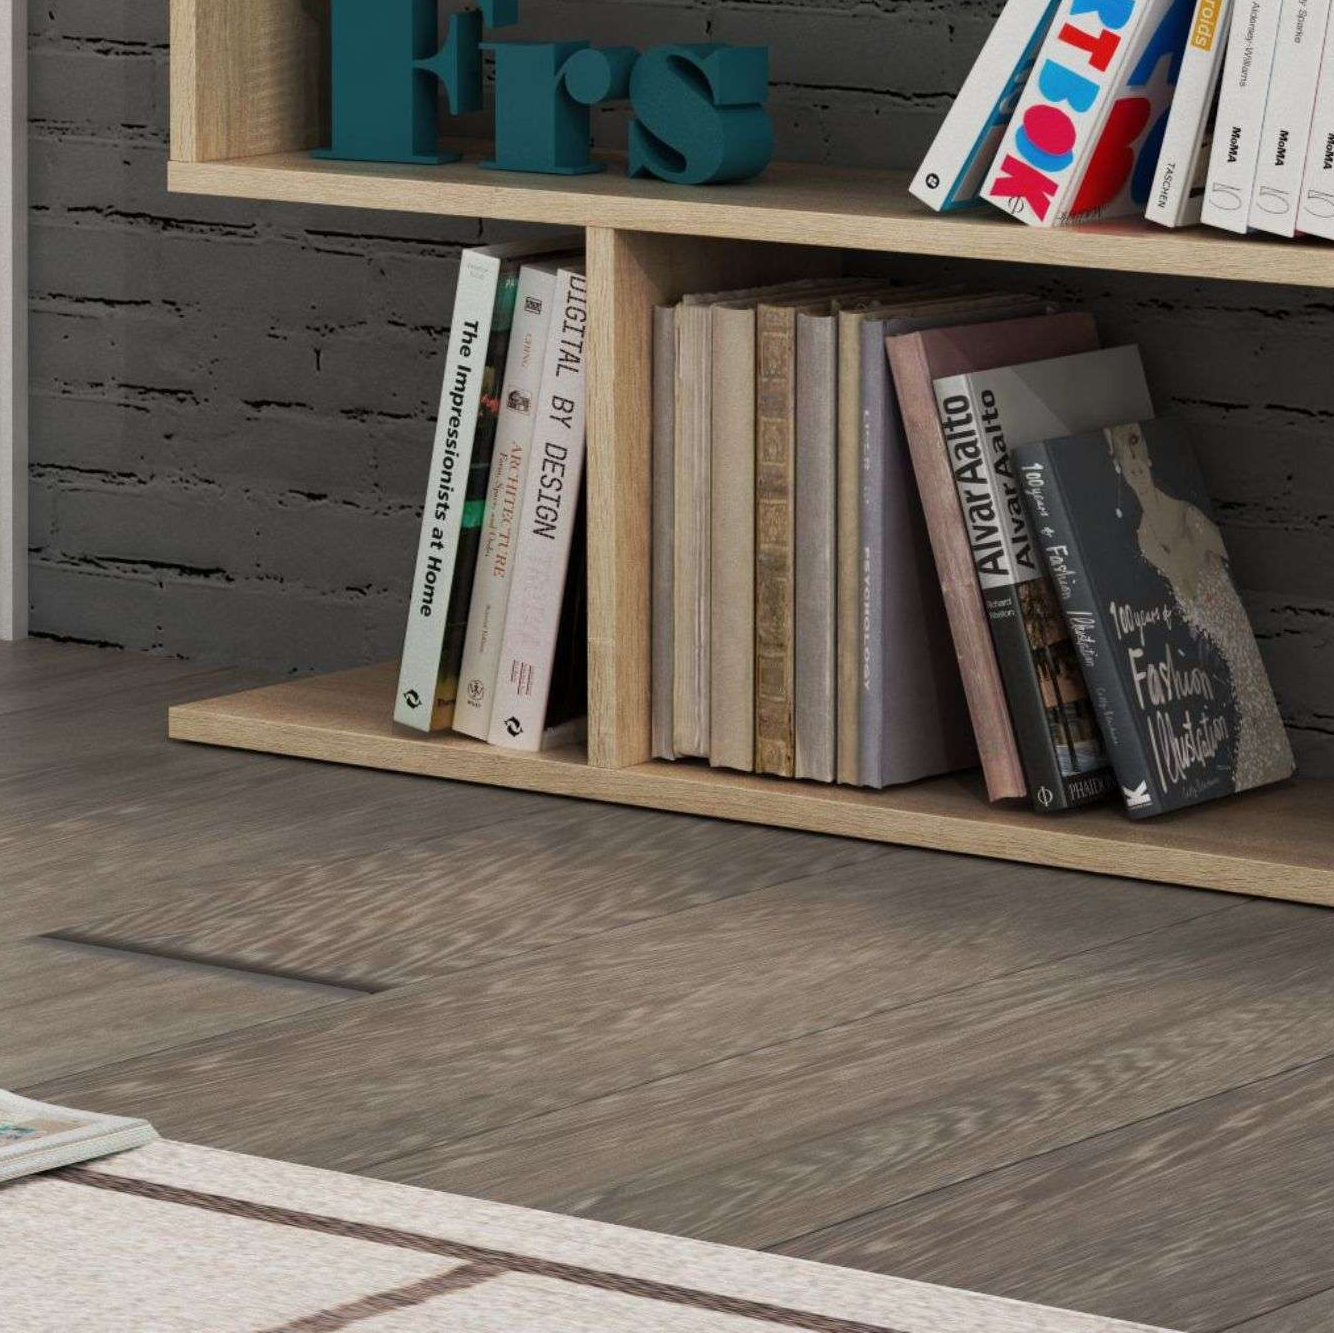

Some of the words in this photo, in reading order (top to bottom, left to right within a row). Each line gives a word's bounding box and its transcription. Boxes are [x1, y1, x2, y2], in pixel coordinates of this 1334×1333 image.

[1294, 9, 1307, 43] Sparke
[989, 58, 1101, 222] BOOK
[1228, 127, 1241, 162] MoMA
[1275, 130, 1289, 165] MoMA
[1158, 164, 1175, 208] TASCHEN
[460, 321, 478, 357] The
[556, 272, 587, 376] DIGITAL
[435, 365, 471, 520] Impressionists
[550, 395, 574, 429] BY
[943, 394, 988, 487] Aalto
[982, 389, 1014, 478] Aalto
[494, 448, 523, 576] ARCHITECTURE
[533, 443, 568, 539] DESIGN
[431, 527, 444, 550] at
[964, 479, 1011, 577] Alvar
[1002, 478, 1037, 572] Alvar
[421, 556, 442, 616] Home
[1046, 545, 1076, 604] Fashion
[1128, 647, 1214, 708] Fashion
